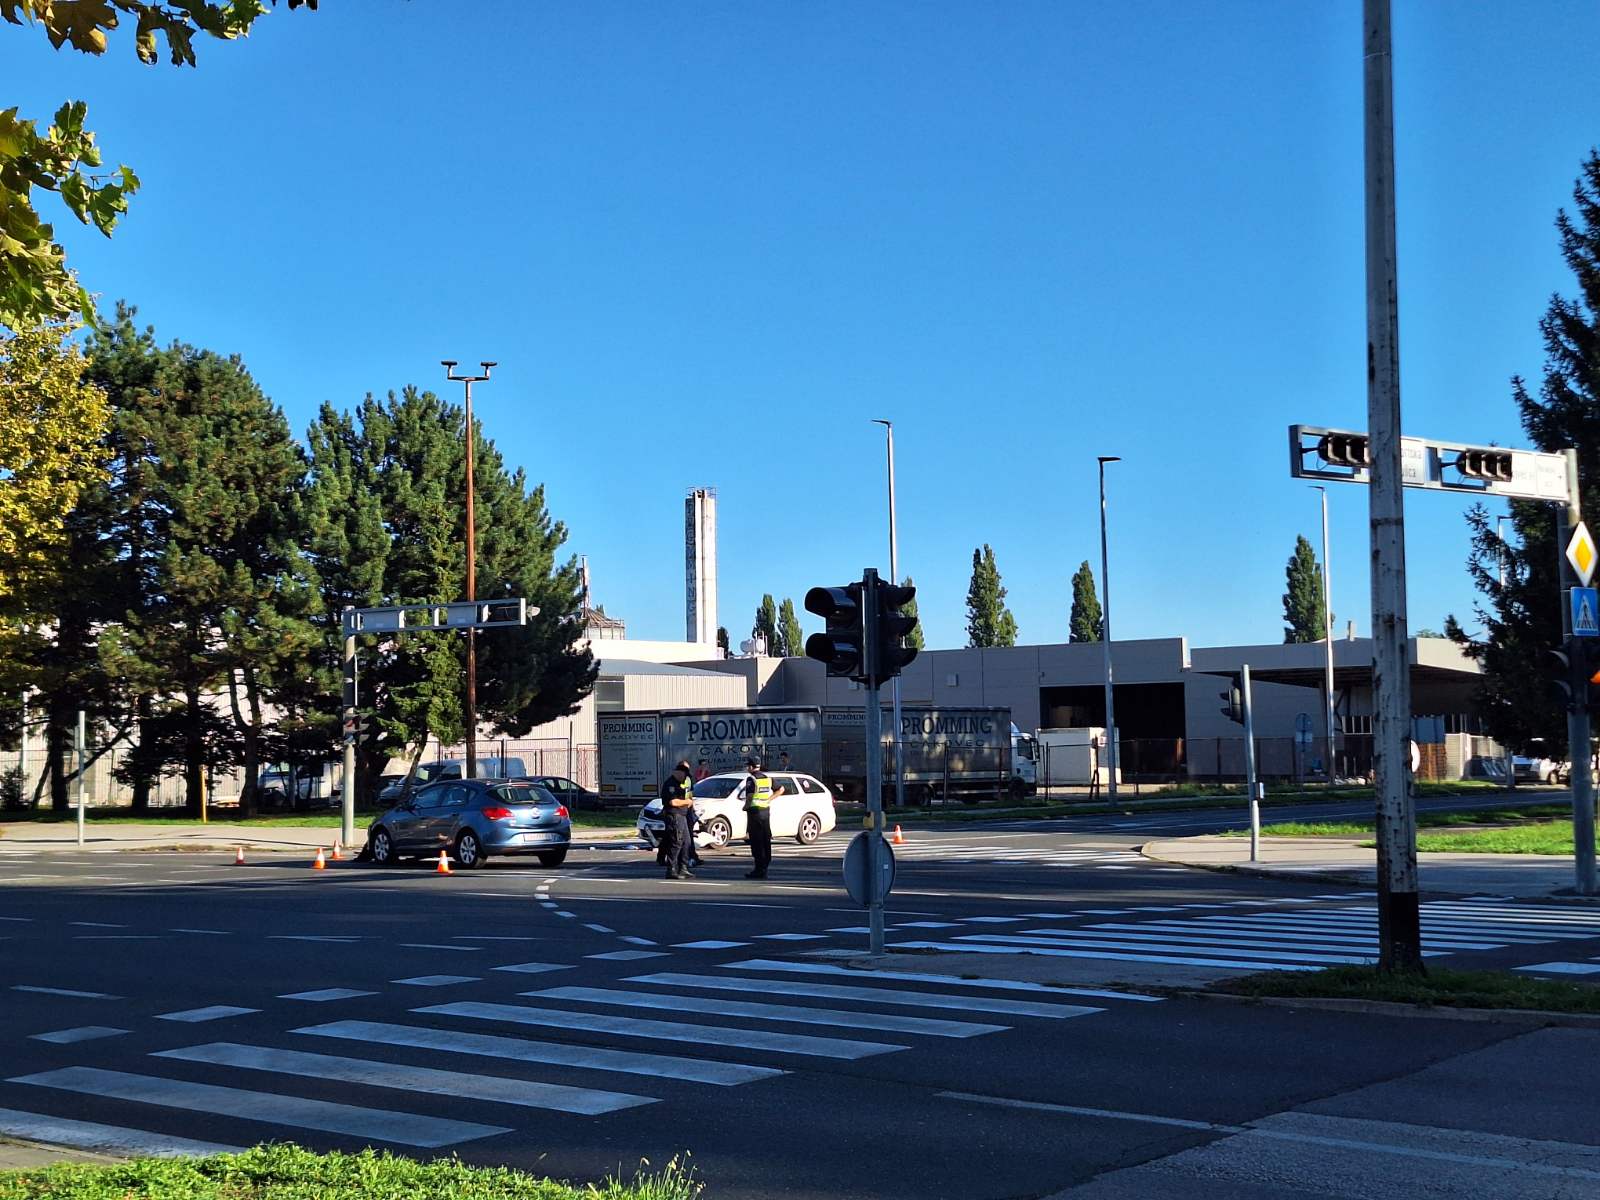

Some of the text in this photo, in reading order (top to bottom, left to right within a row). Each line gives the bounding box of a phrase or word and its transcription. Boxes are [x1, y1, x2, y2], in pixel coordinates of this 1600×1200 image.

[603, 723, 654, 733] PROMMING
[688, 718, 798, 741] PROMMING
[902, 717, 992, 736] PROMMING
